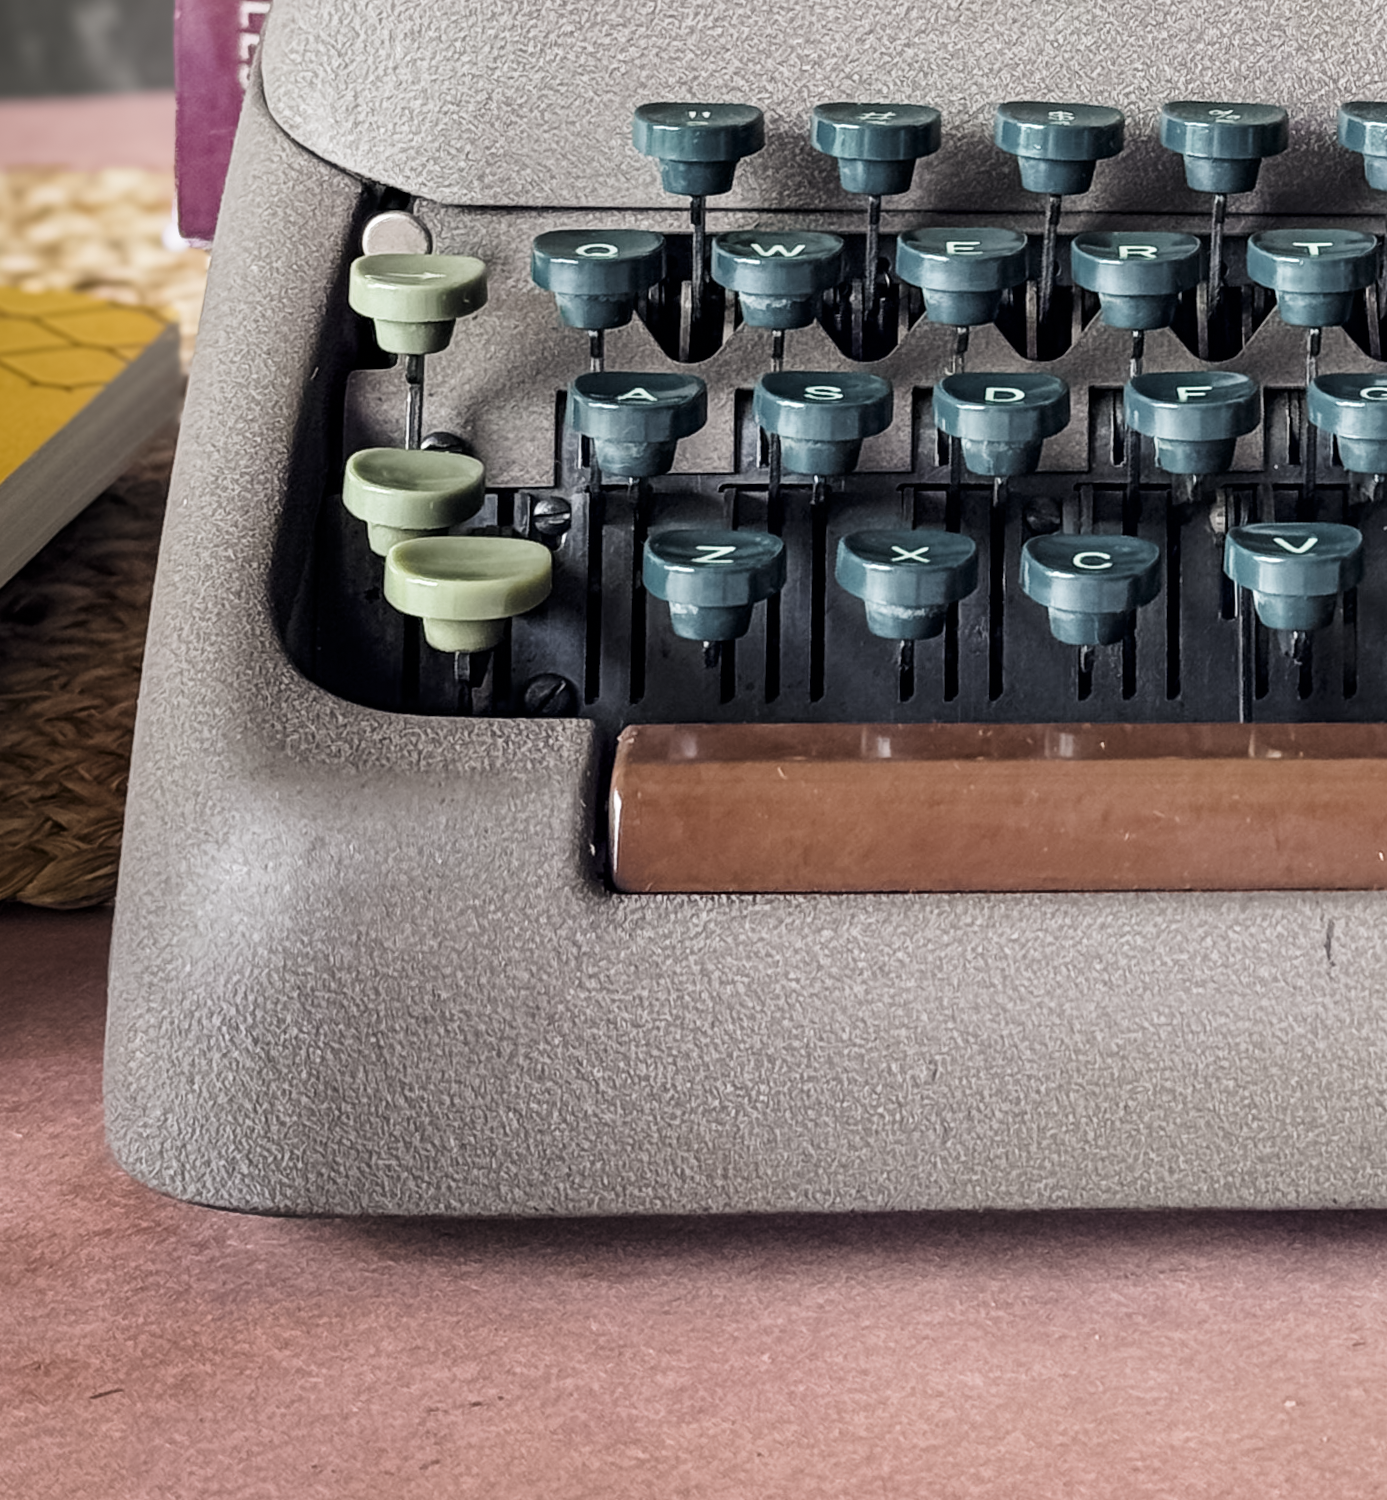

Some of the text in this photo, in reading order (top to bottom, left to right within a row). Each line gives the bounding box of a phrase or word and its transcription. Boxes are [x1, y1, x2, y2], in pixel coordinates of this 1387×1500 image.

[575, 243, 618, 259] Q
[751, 243, 805, 257] W
[946, 241, 983, 255] E
[1118, 245, 1158, 260] R
[1293, 242, 1333, 256] T
[617, 387, 657, 402] A
[804, 385, 843, 401] S
[984, 386, 1026, 402] D
[1176, 385, 1213, 401] F
[1273, 536, 1318, 555] V
[691, 545, 737, 564] Z
[890, 545, 931, 564] X
[1073, 551, 1113, 570] C
